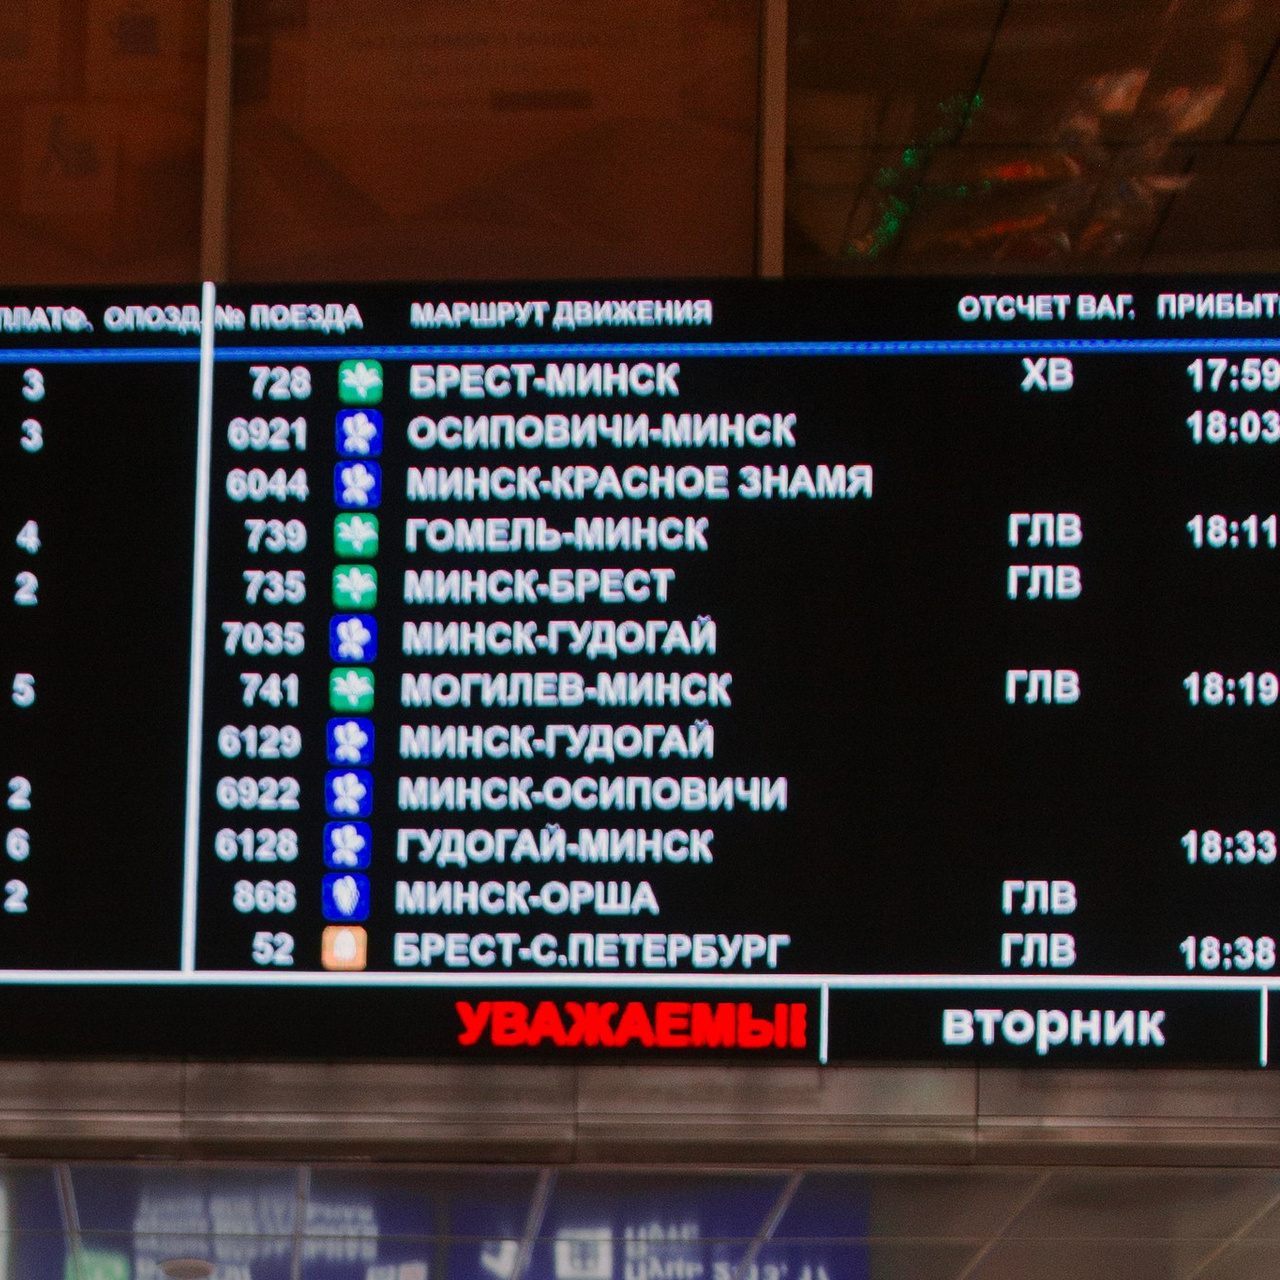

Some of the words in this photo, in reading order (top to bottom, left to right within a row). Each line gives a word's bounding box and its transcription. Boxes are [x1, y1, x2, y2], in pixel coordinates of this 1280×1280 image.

[104, 305, 202, 334] ОПОЗД
[250, 303, 364, 334] ПОЕЗДА
[410, 301, 550, 328] МАРШРУТ
[552, 299, 713, 329] ДВИЖЕНИЯ
[958, 294, 1071, 319] ОТСЧЕТ
[1077, 294, 1135, 319] ВАГ.
[1158, 292, 1280, 318] ПРИБЫТ
[23, 368, 45, 399] 3
[250, 365, 312, 399] 728
[410, 362, 681, 397] БРЕСТ-МИНСК
[1022, 357, 1074, 390] ХВ
[1188, 357, 1280, 390] 17:59
[22, 418, 44, 450] 3
[228, 416, 308, 450] 6921
[408, 413, 797, 449] ОСИПОВИЧИ-МИНСК
[1188, 410, 1280, 443] 18:03
[227, 467, 310, 501] 6044
[408, 465, 730, 500] МИНСК-КРАСНОЕ
[738, 464, 873, 499] ЗНАМЯ
[17, 520, 41, 552] 4
[245, 518, 307, 552] 739
[406, 516, 710, 552] ГОМЕЛЬ-МИНСК
[1010, 513, 1083, 547] ГЛВ
[1188, 514, 1278, 548] 18:11
[15, 571, 39, 605] 2
[244, 570, 307, 604] 735
[404, 568, 676, 604] МИНСК-БРЕСТ
[1009, 565, 1082, 599] ГЛВ
[221, 621, 305, 655] 7035
[403, 614, 717, 659] МИНСК-ГУДОГАЙ
[13, 673, 35, 706] 5
[241, 672, 299, 707] 741
[401, 671, 733, 707] МОГИЛЕВ-МИНСК
[1007, 669, 1081, 704] ГЛВ
[1185, 671, 1280, 706] 18:19
[218, 724, 303, 759] 6129
[400, 718, 715, 763] МИНСК-ГУДОГАЙ
[8, 775, 32, 810] 2
[217, 776, 301, 810] 6922
[399, 776, 788, 811] МИНСК-ОСИПОВИЧИ
[7, 827, 30, 860] 6
[215, 827, 299, 862] 6128
[397, 822, 715, 868] ГУДОГАЙ-МИНСК
[1182, 829, 1277, 864] 18:33
[5, 879, 28, 912] 2
[233, 879, 297, 914] 868
[396, 880, 660, 915] МИНСК-ОРША
[1004, 880, 1078, 915] ГЛВ
[252, 931, 295, 966] 52
[394, 932, 791, 968] БРЕСТ-С.ПЕТЕРБУРГ
[1002, 932, 1077, 968] ГЛВ
[1181, 935, 1277, 970] 18:38
[943, 1007, 1166, 1055] вторник
